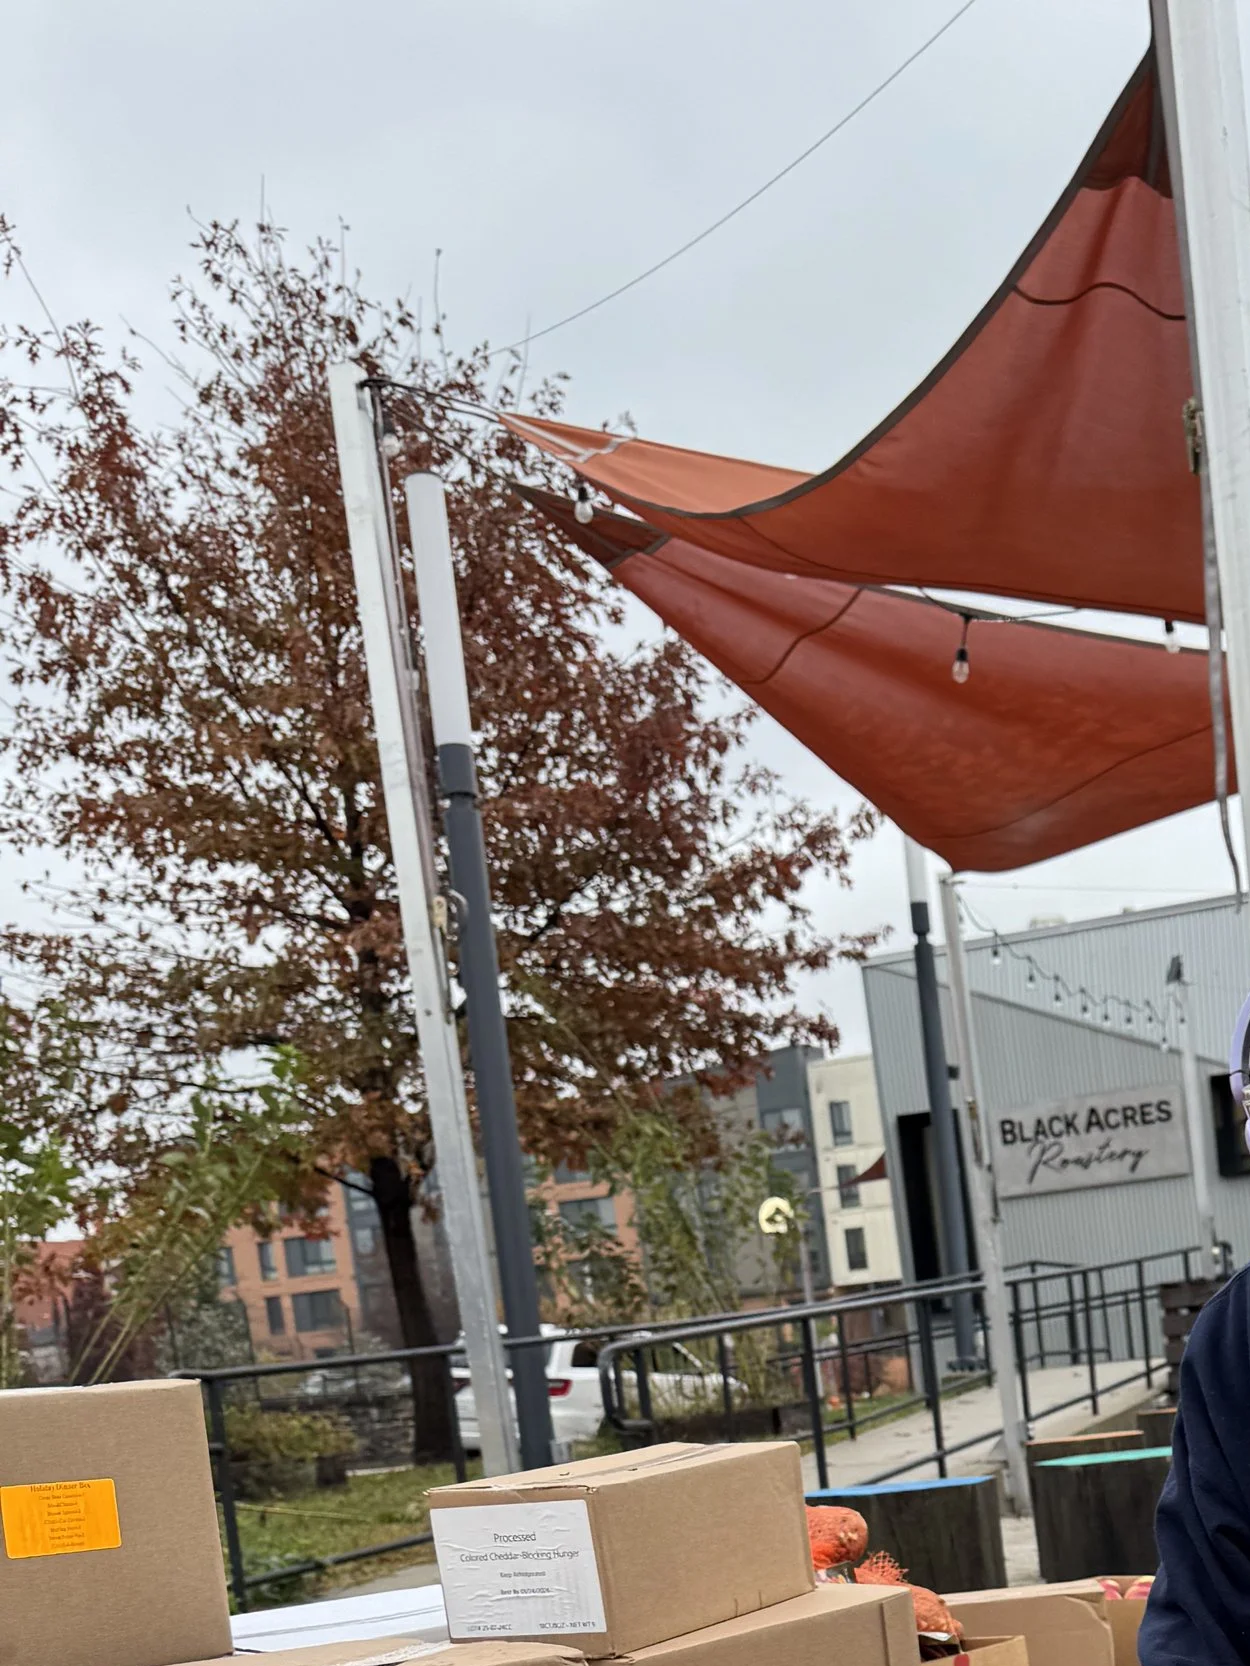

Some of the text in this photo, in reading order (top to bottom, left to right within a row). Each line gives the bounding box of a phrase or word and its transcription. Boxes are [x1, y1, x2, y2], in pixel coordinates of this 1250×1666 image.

[1000, 1099, 1173, 1146] BLACK ACRES
[493, 1531, 537, 1543] Processed
[459, 1553, 488, 1563] Colored
